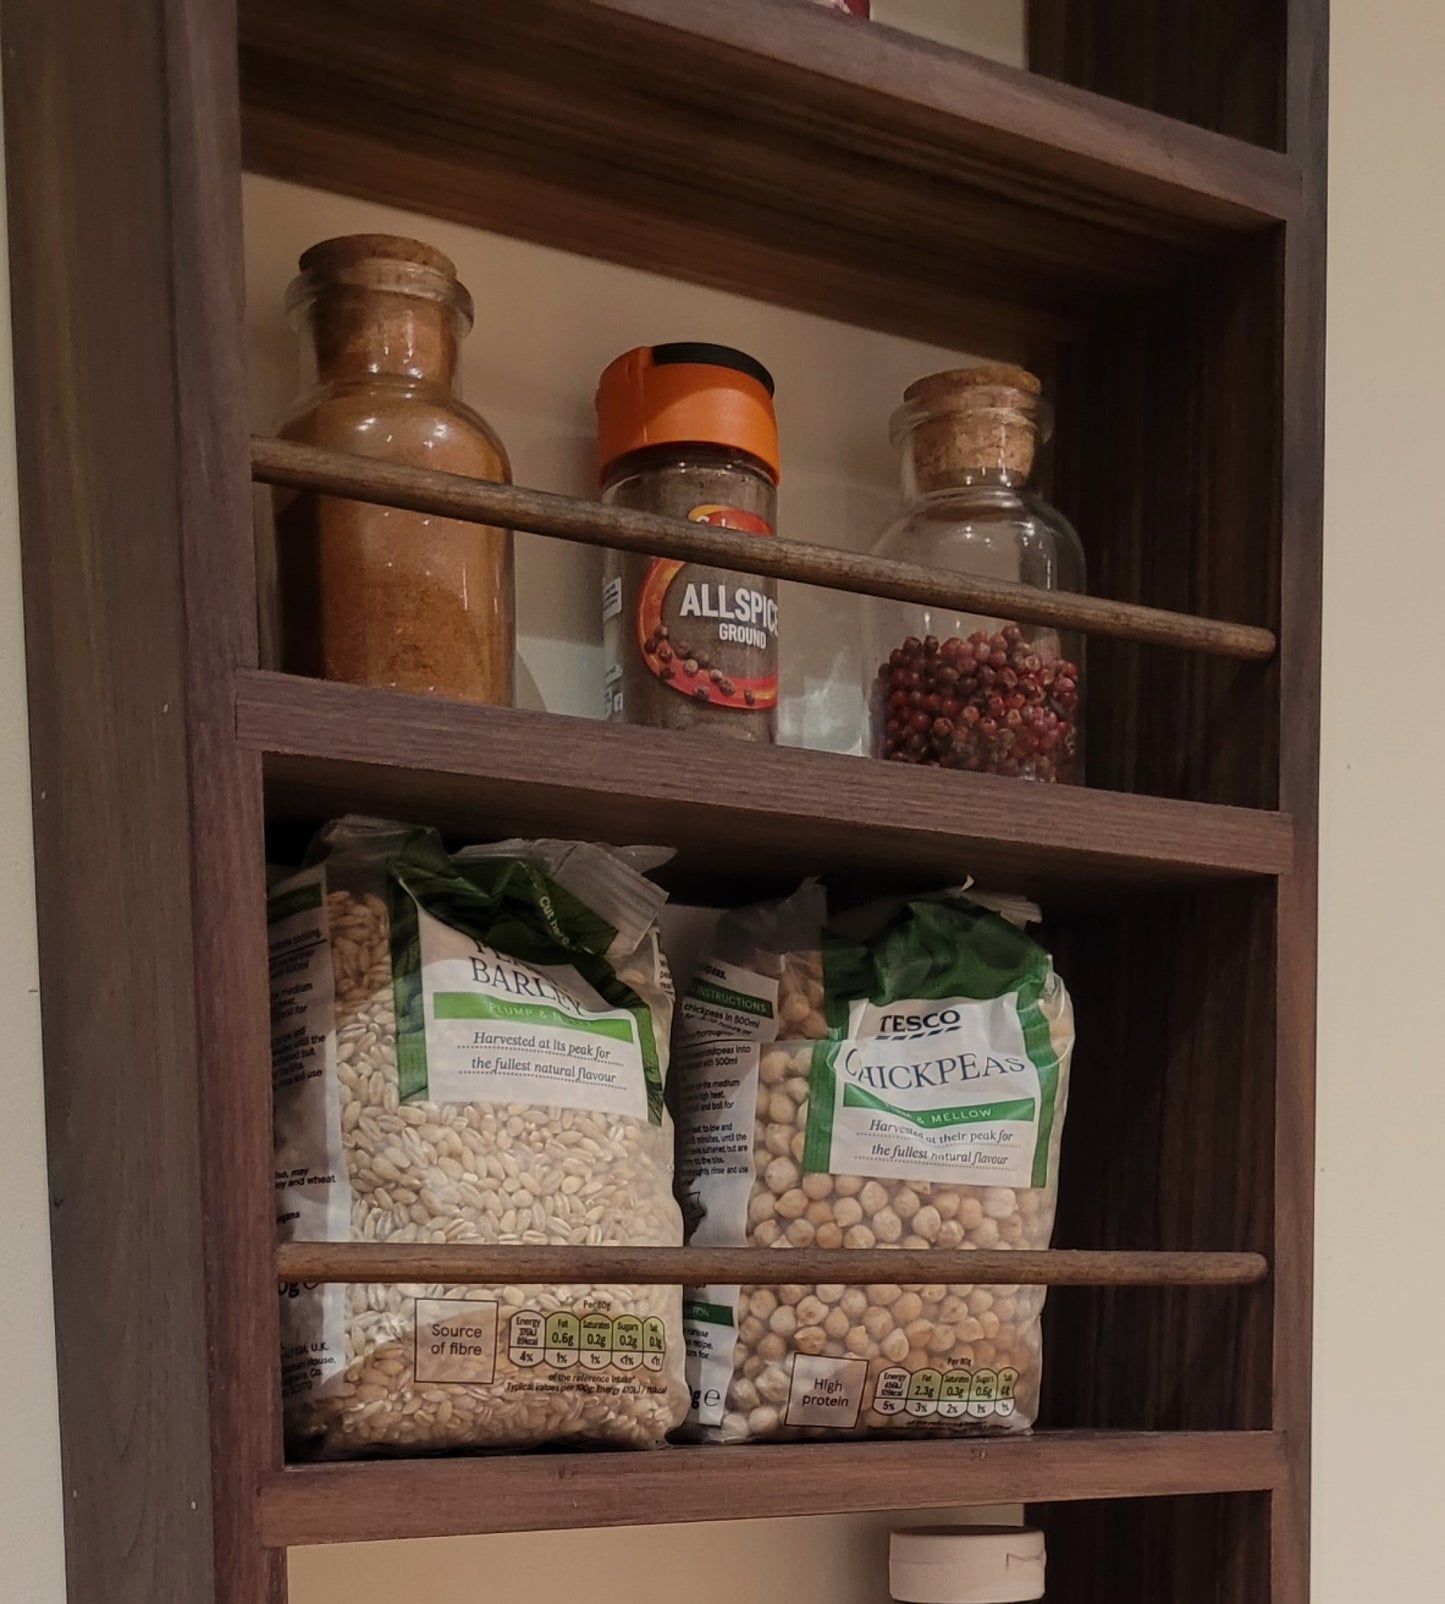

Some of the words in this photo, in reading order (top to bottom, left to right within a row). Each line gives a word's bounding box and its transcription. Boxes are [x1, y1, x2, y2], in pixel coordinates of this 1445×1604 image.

[719, 622, 766, 650] GROUND
[489, 1002, 533, 1017] PLUMP
[734, 1013, 760, 1029] 500ml
[879, 1009, 961, 1033] TESCO
[473, 1031, 536, 1047] Harvested
[538, 1038, 550, 1050] at
[553, 1038, 566, 1051] its
[568, 1044, 593, 1059] peak
[594, 1045, 611, 1060] for
[471, 1056, 492, 1070] the
[493, 1057, 530, 1073] fullest
[534, 1063, 576, 1078] natural
[575, 1067, 617, 1084] flavour
[931, 1108, 993, 1124] MELLOW
[869, 1118, 924, 1140] Harvested
[939, 1129, 967, 1144] their
[970, 1129, 996, 1143] peak
[996, 1129, 1014, 1146] for
[871, 1142, 890, 1156] the
[890, 1143, 928, 1160] fullest
[931, 1149, 971, 1163] natural
[971, 1150, 1009, 1166] flavour
[515, 1317, 541, 1330] Energy
[557, 1319, 569, 1329] Fat
[617, 1321, 639, 1332] Sugars
[431, 1324, 483, 1339] Source
[551, 1332, 574, 1347] 0.6g
[587, 1333, 606, 1348] 0.2g
[619, 1335, 637, 1349] 0.2g
[430, 1342, 448, 1355] of
[450, 1342, 483, 1356] fibre
[519, 1350, 533, 1363] 4%
[556, 1352, 568, 1364] 1%
[590, 1353, 601, 1365] 1%
[883, 1373, 907, 1383] Energy
[921, 1374, 932, 1383] Fat
[814, 1378, 843, 1393] High
[914, 1385, 934, 1398] 2.3g
[946, 1386, 964, 1399] 0.3g
[975, 1386, 992, 1398] 0.6g
[801, 1394, 849, 1408] protein
[882, 1401, 895, 1411] 5%
[914, 1402, 928, 1413] 3%
[946, 1403, 958, 1414] 2%
